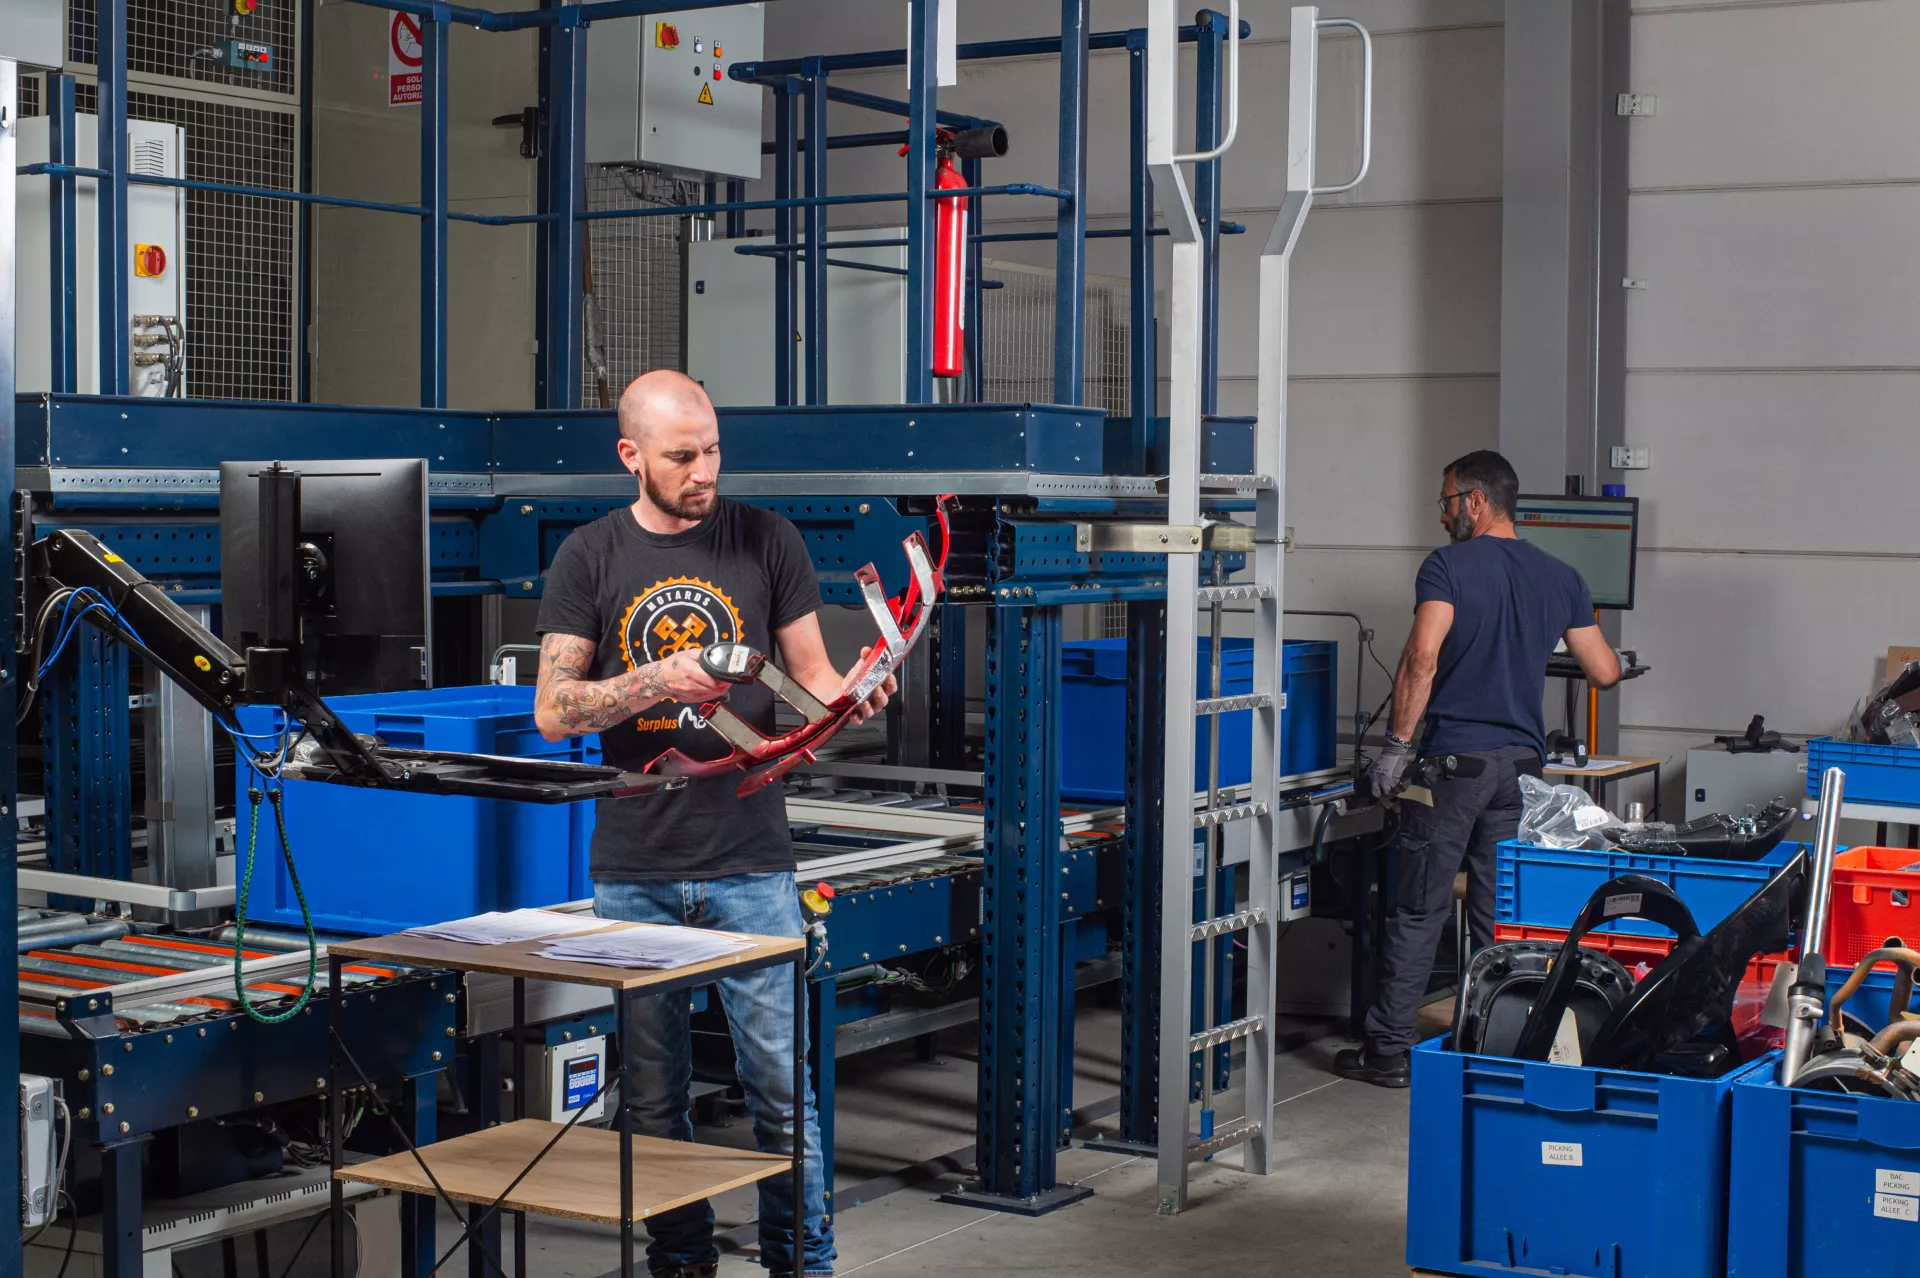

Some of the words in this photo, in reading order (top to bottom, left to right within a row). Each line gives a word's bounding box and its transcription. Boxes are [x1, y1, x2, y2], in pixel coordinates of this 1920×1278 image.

[397, 84, 422, 92] PERSO
[646, 590, 711, 612] MOTARDS
[637, 716, 678, 732] Surplus
[1883, 1181, 1910, 1190] PICKING
[1882, 1197, 1909, 1206] PICKING
[1881, 1206, 1900, 1214] ALLEE
